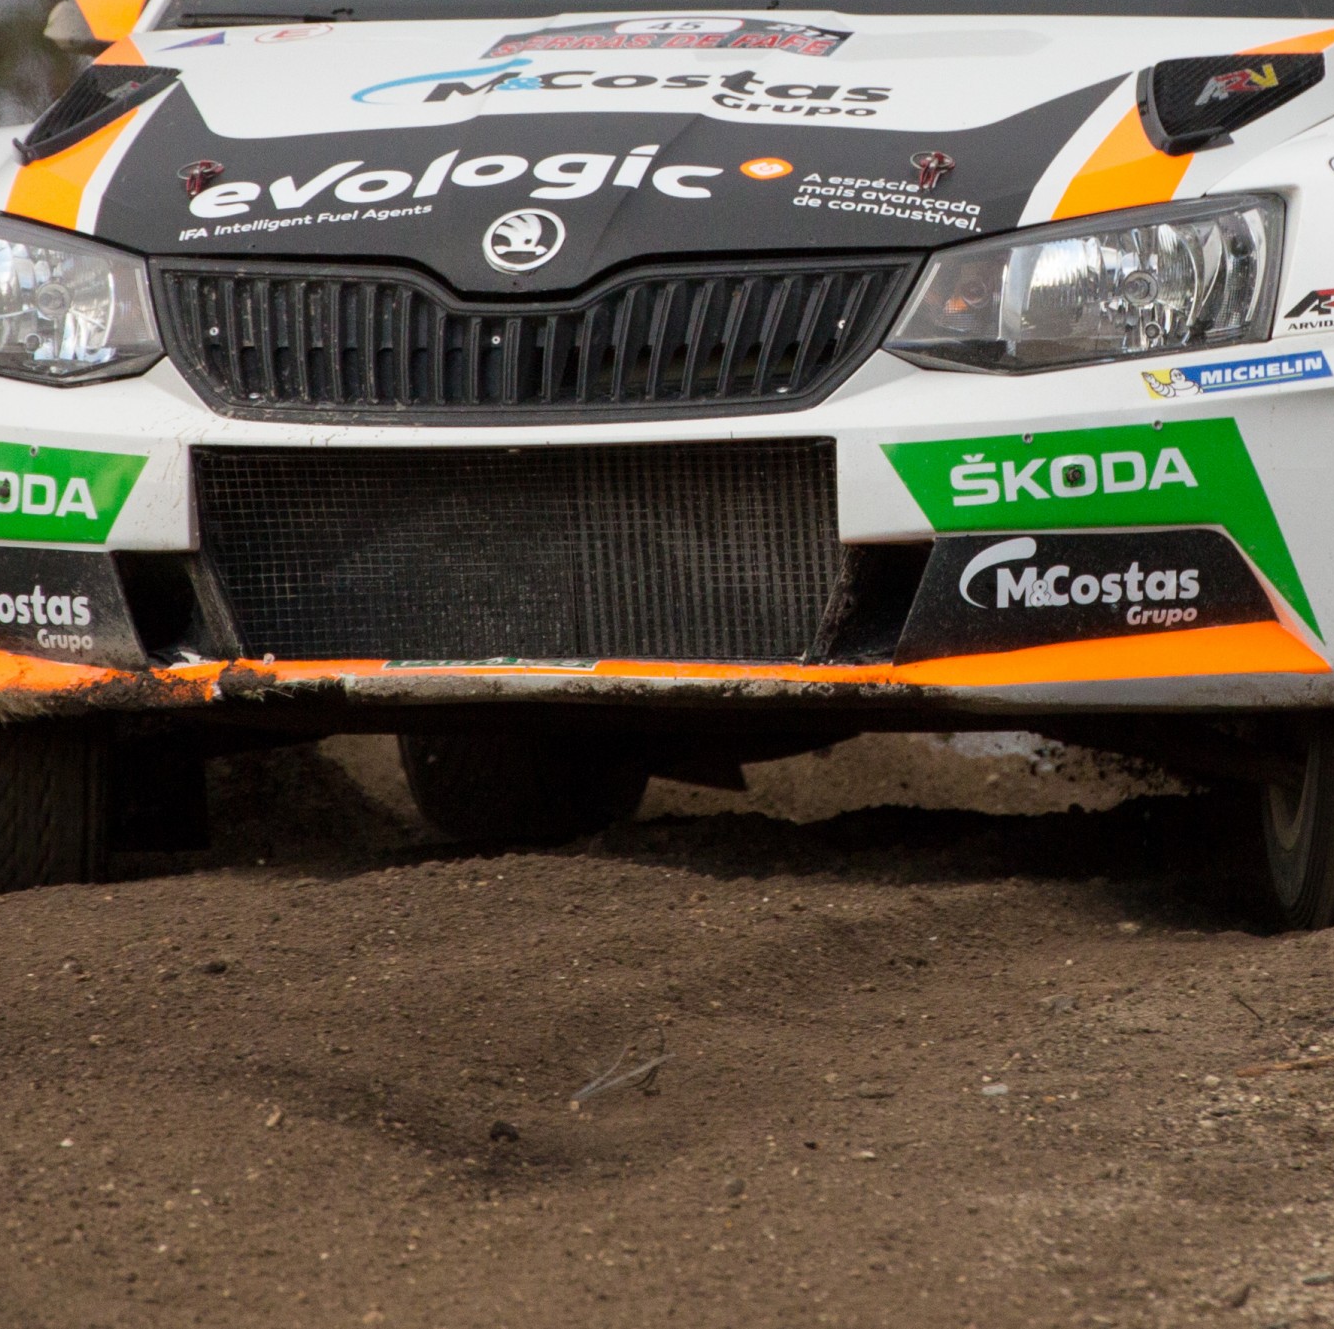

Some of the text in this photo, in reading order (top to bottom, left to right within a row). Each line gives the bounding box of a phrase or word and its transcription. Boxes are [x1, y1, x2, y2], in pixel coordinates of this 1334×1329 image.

[647, 20, 841, 40] 45 2017
[490, 33, 836, 58] SERRAS DE FAFE
[711, 92, 878, 118] Grupo
[188, 144, 724, 218] evologic
[802, 173, 919, 193] A espécie
[793, 194, 822, 208] de
[798, 183, 981, 216] mais avançada
[178, 203, 433, 241] IFA Intelligent Fuel Agents
[1200, 356, 1323, 385] MICHELIN
[950, 447, 1199, 507] ŠKODA
[996, 561, 1200, 609] M&Costas
[1126, 605, 1197, 627] Grupo
[37, 628, 94, 653] Grupo
